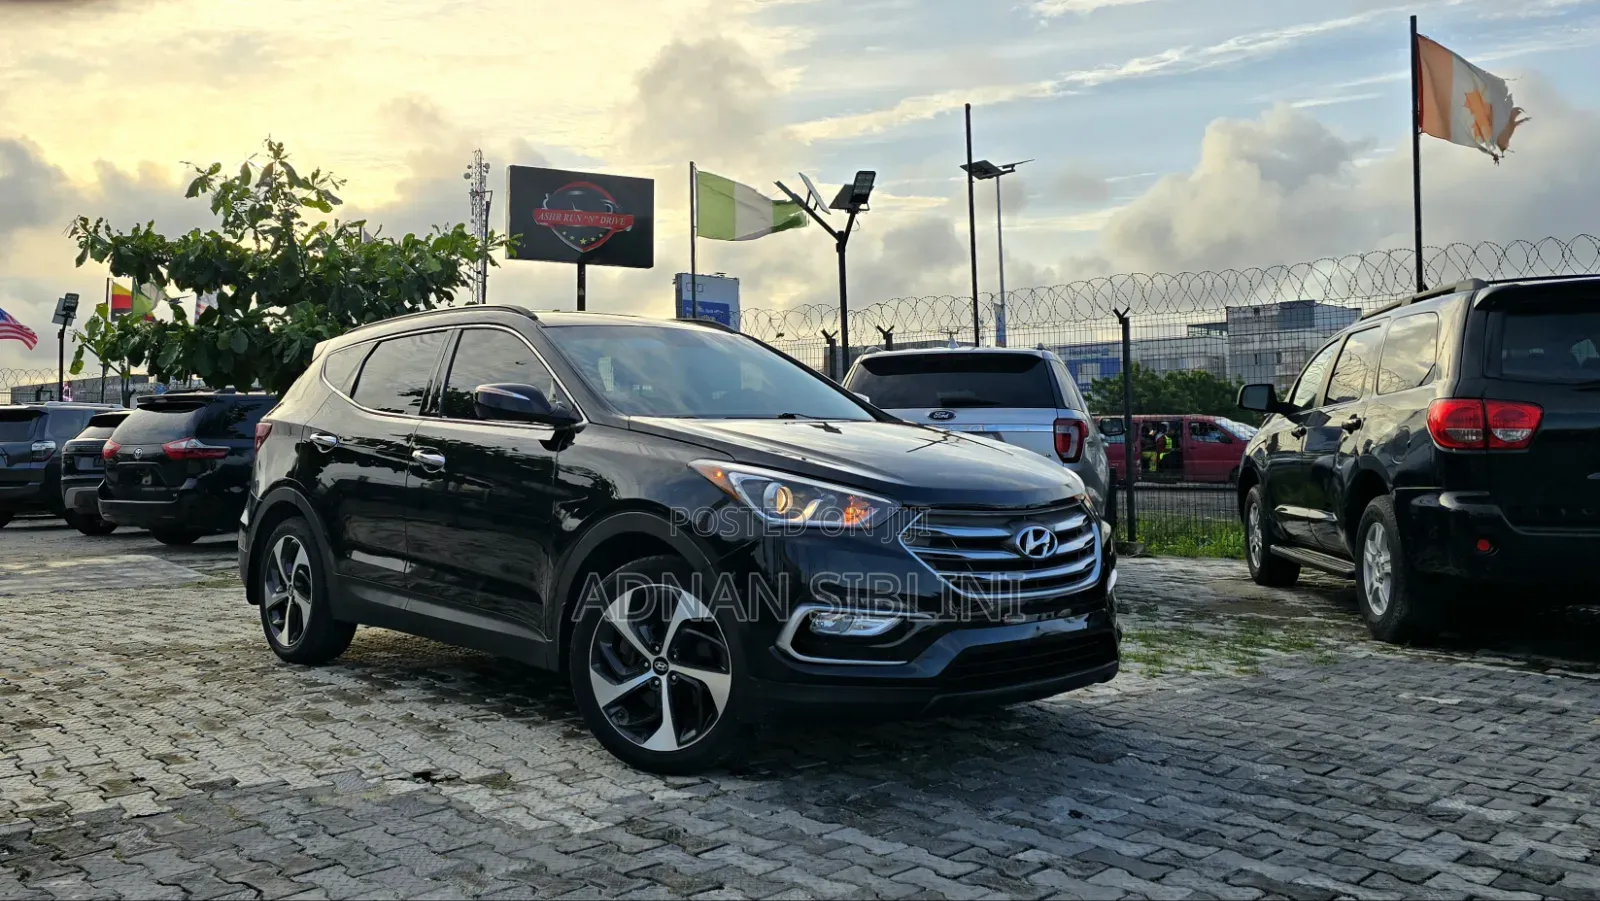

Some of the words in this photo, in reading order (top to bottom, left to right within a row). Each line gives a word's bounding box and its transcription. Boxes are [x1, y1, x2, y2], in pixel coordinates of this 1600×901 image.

[538, 212, 562, 221] ASHR
[563, 213, 582, 222] RUN
[600, 216, 626, 226] DRIVE
